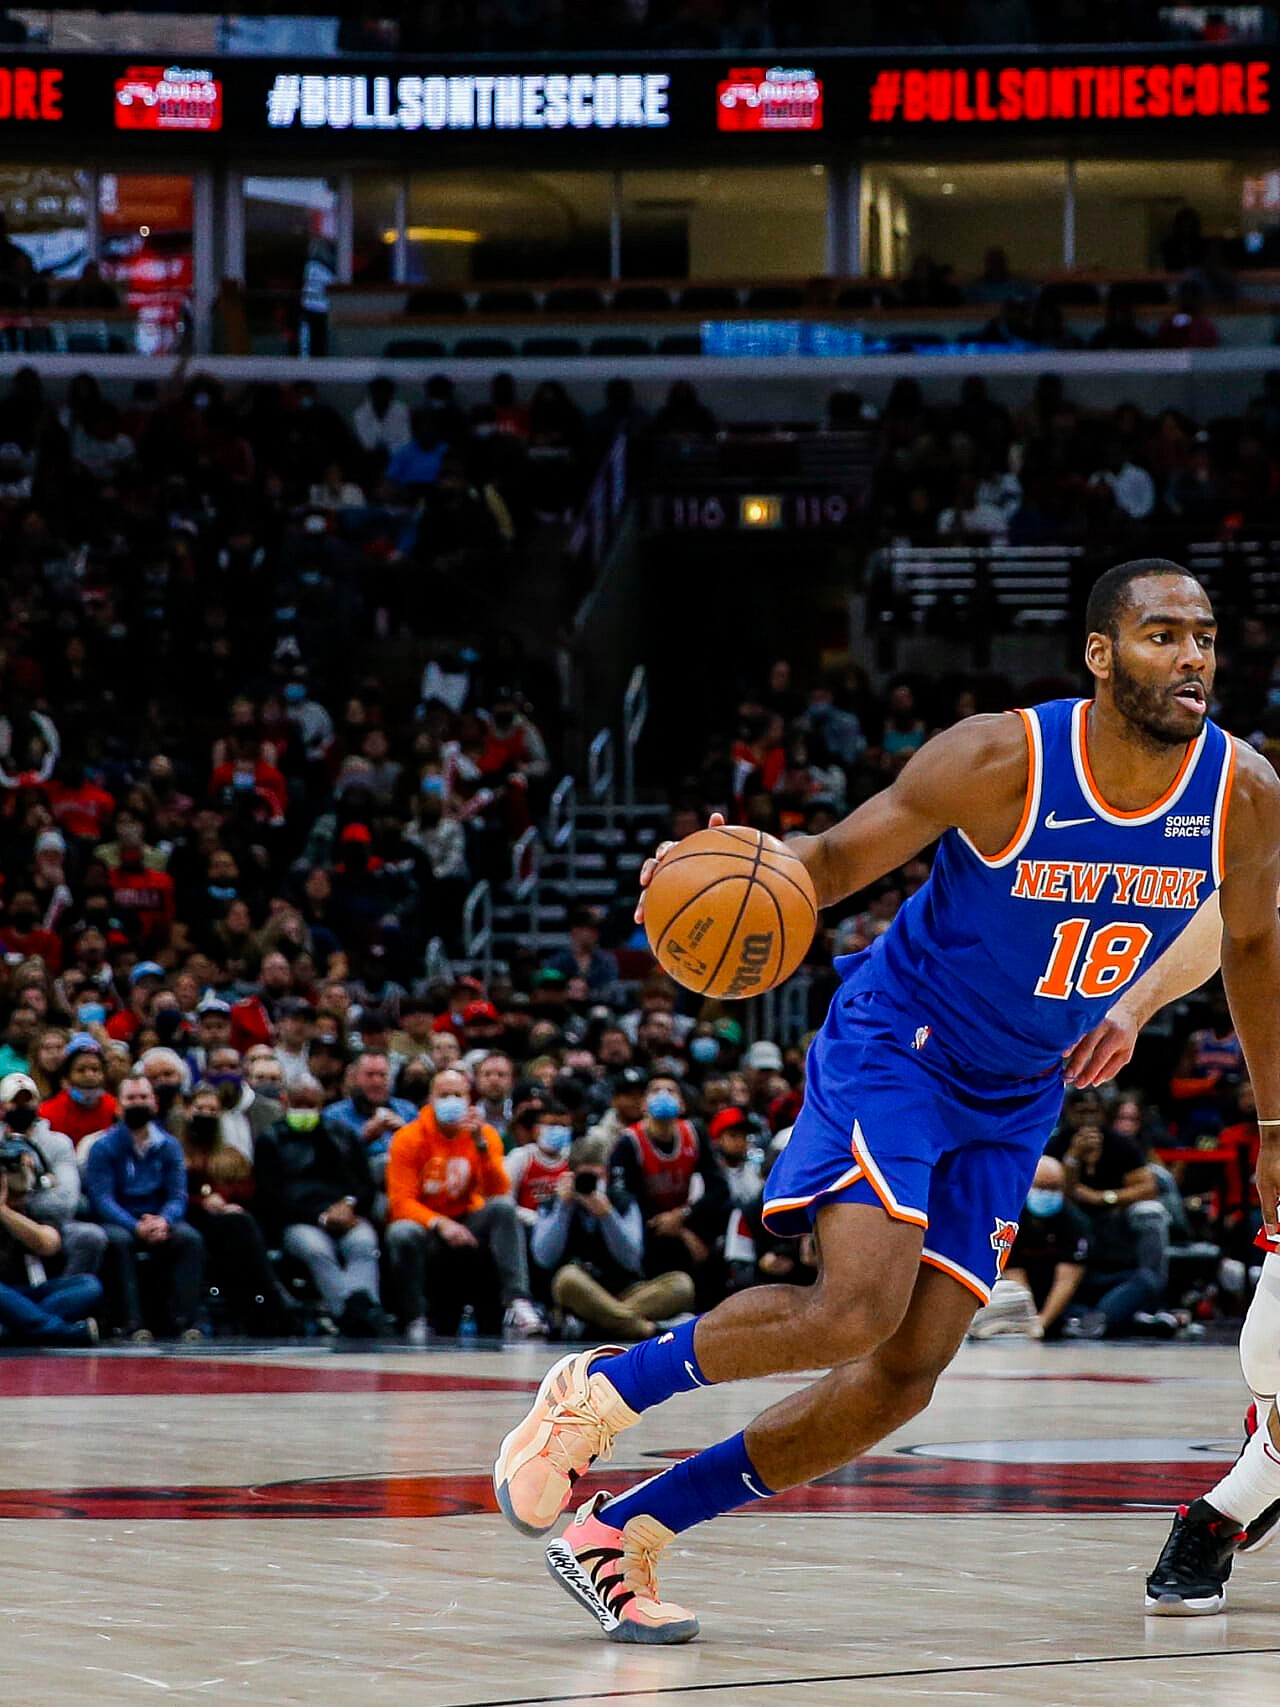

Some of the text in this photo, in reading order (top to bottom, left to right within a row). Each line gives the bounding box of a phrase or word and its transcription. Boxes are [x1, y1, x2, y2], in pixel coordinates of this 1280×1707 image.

[266, 74, 671, 129] #BULLSONTHESCORE
[869, 62, 1271, 122] #BULLSONTHESCORE
[1164, 826, 1200, 838] SPACE
[1165, 815, 1211, 827] SQUARE
[1011, 859, 1207, 910] NEW YORK
[1034, 917, 1153, 1000] 18
